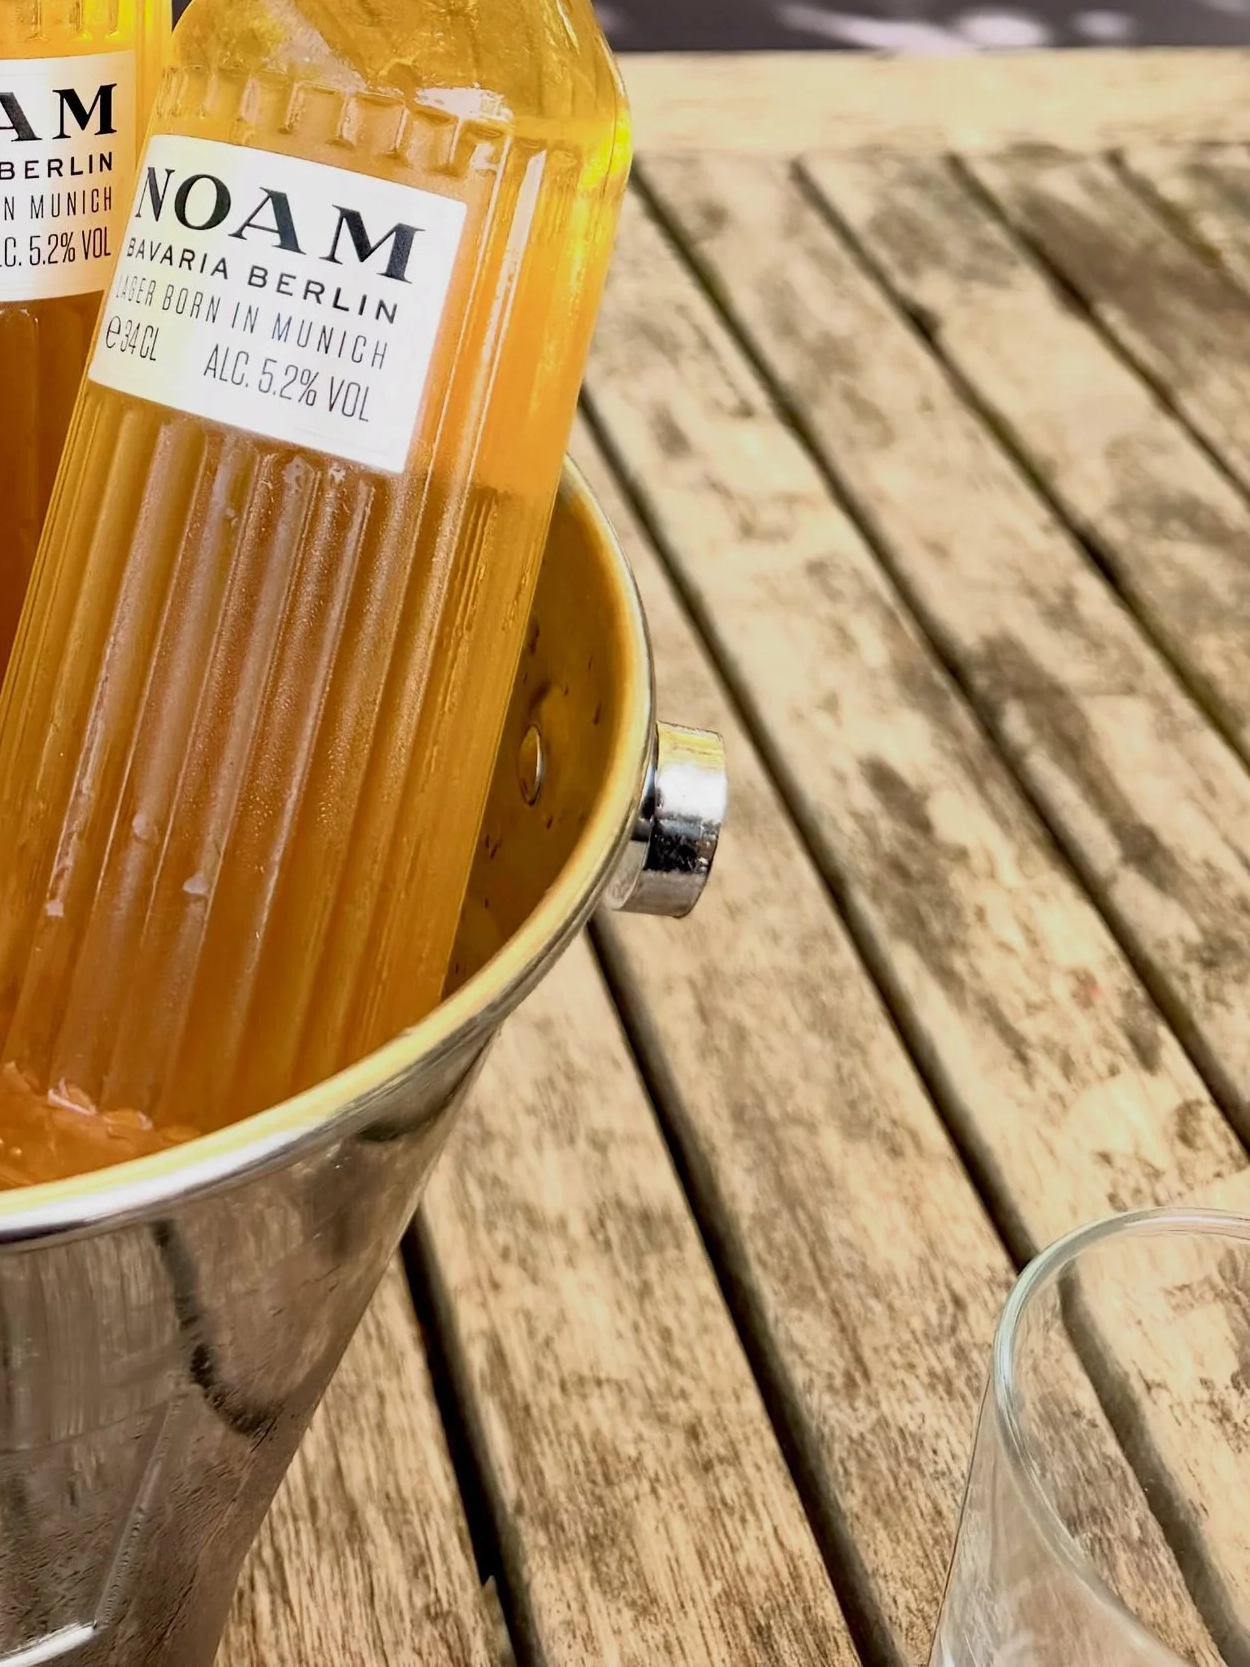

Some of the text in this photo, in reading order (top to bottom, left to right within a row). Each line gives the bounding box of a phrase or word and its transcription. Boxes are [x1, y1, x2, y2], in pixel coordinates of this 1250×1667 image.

[30, 186, 112, 219] MUNICH
[135, 166, 426, 284] NOAM
[29, 232, 76, 266] 5.2%
[82, 226, 111, 259] VOL
[126, 237, 399, 325] BAVARIA BERLIN
[115, 274, 388, 370] LAGER BORN IN MUNICH
[203, 343, 249, 388] ALC.
[258, 358, 320, 407] 5.2%
[328, 375, 370, 423] VOL
